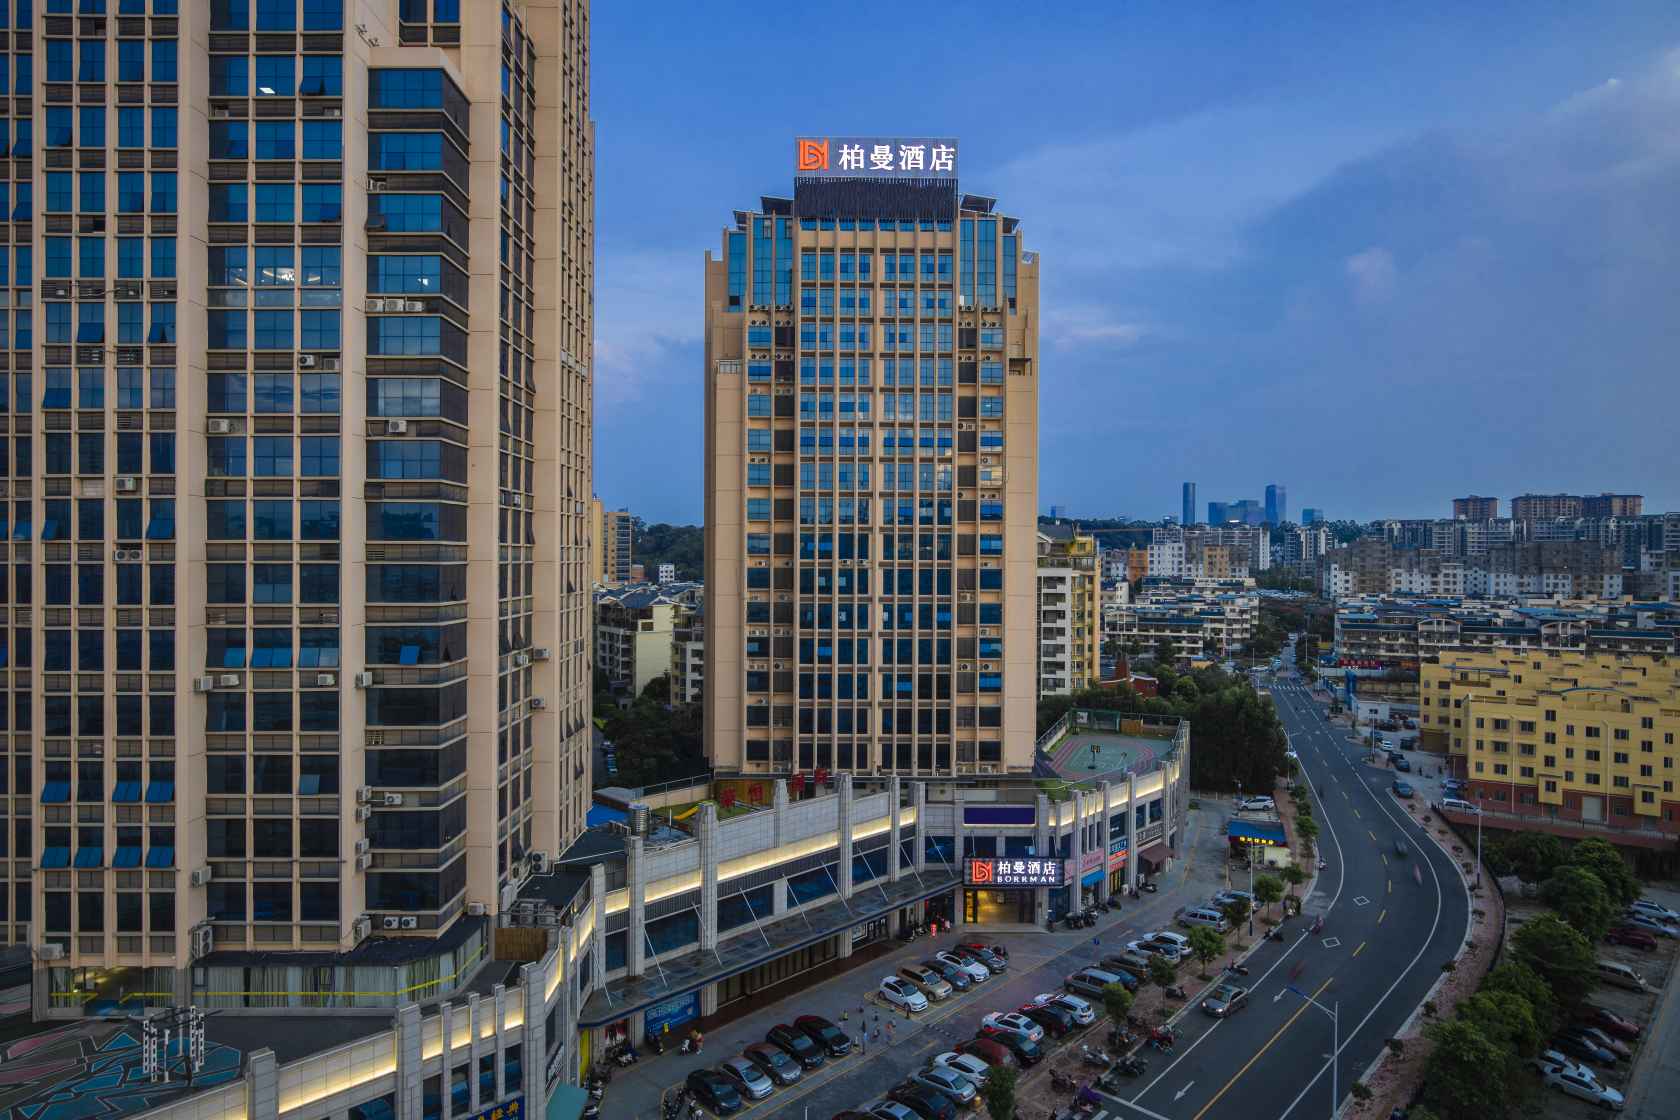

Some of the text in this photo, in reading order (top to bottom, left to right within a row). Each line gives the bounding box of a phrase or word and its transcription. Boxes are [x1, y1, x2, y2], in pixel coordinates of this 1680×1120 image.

[838, 144, 956, 171] 柏曼酒店
[997, 861, 1056, 875] 柏曼酒店
